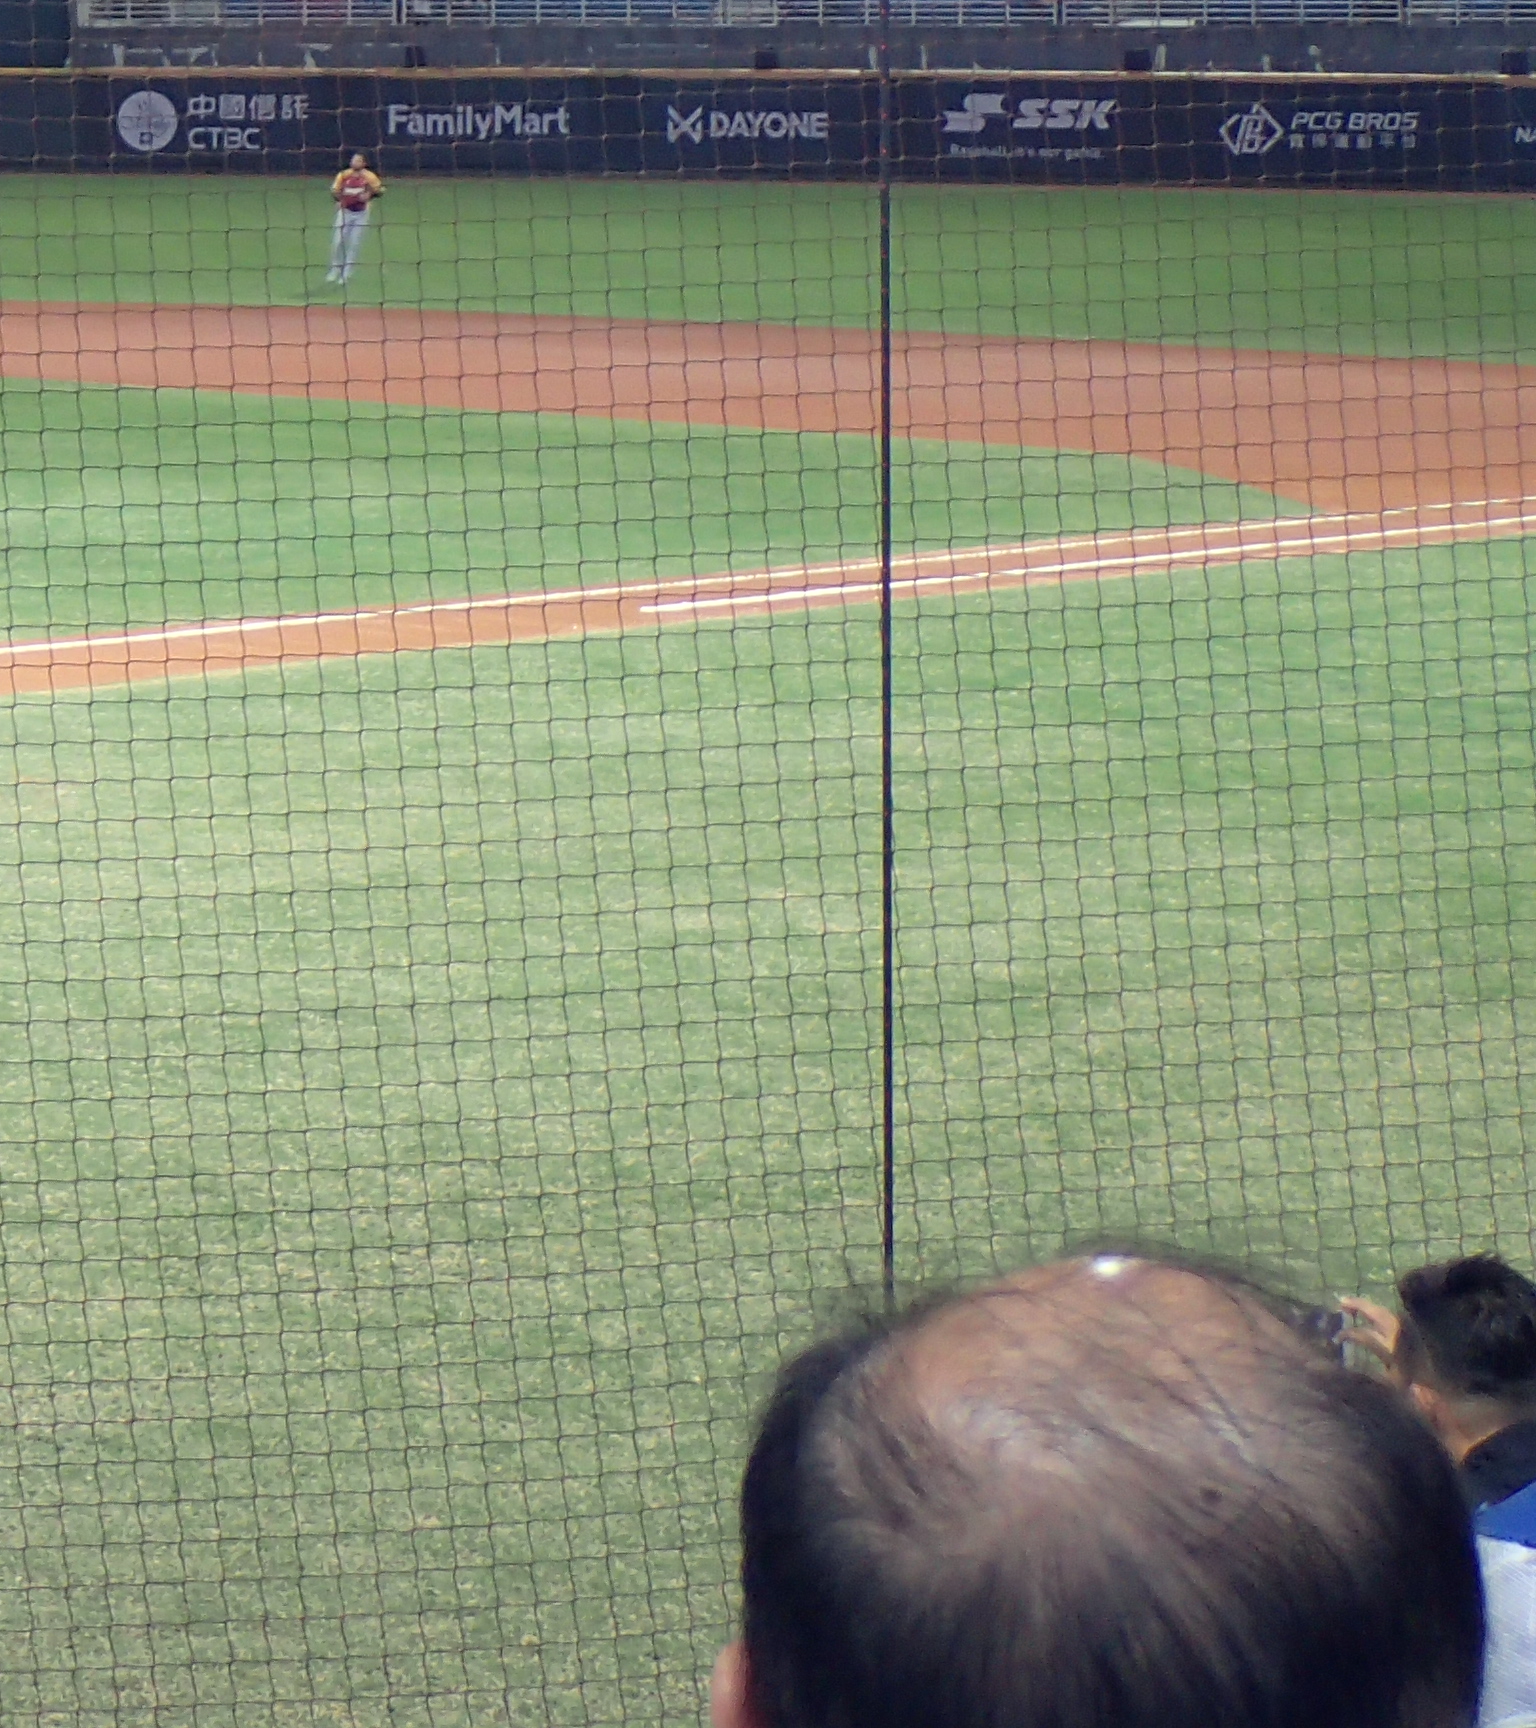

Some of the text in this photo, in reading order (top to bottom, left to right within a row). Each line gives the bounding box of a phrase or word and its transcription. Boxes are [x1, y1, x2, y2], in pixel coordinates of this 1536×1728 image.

[188, 93, 310, 121] 中國信託
[1012, 98, 1118, 129] SSK
[387, 104, 570, 140] FamilyMart
[710, 110, 829, 139] DAYONE
[1291, 112, 1420, 131] PCG BROS
[189, 126, 261, 149] CTBC
